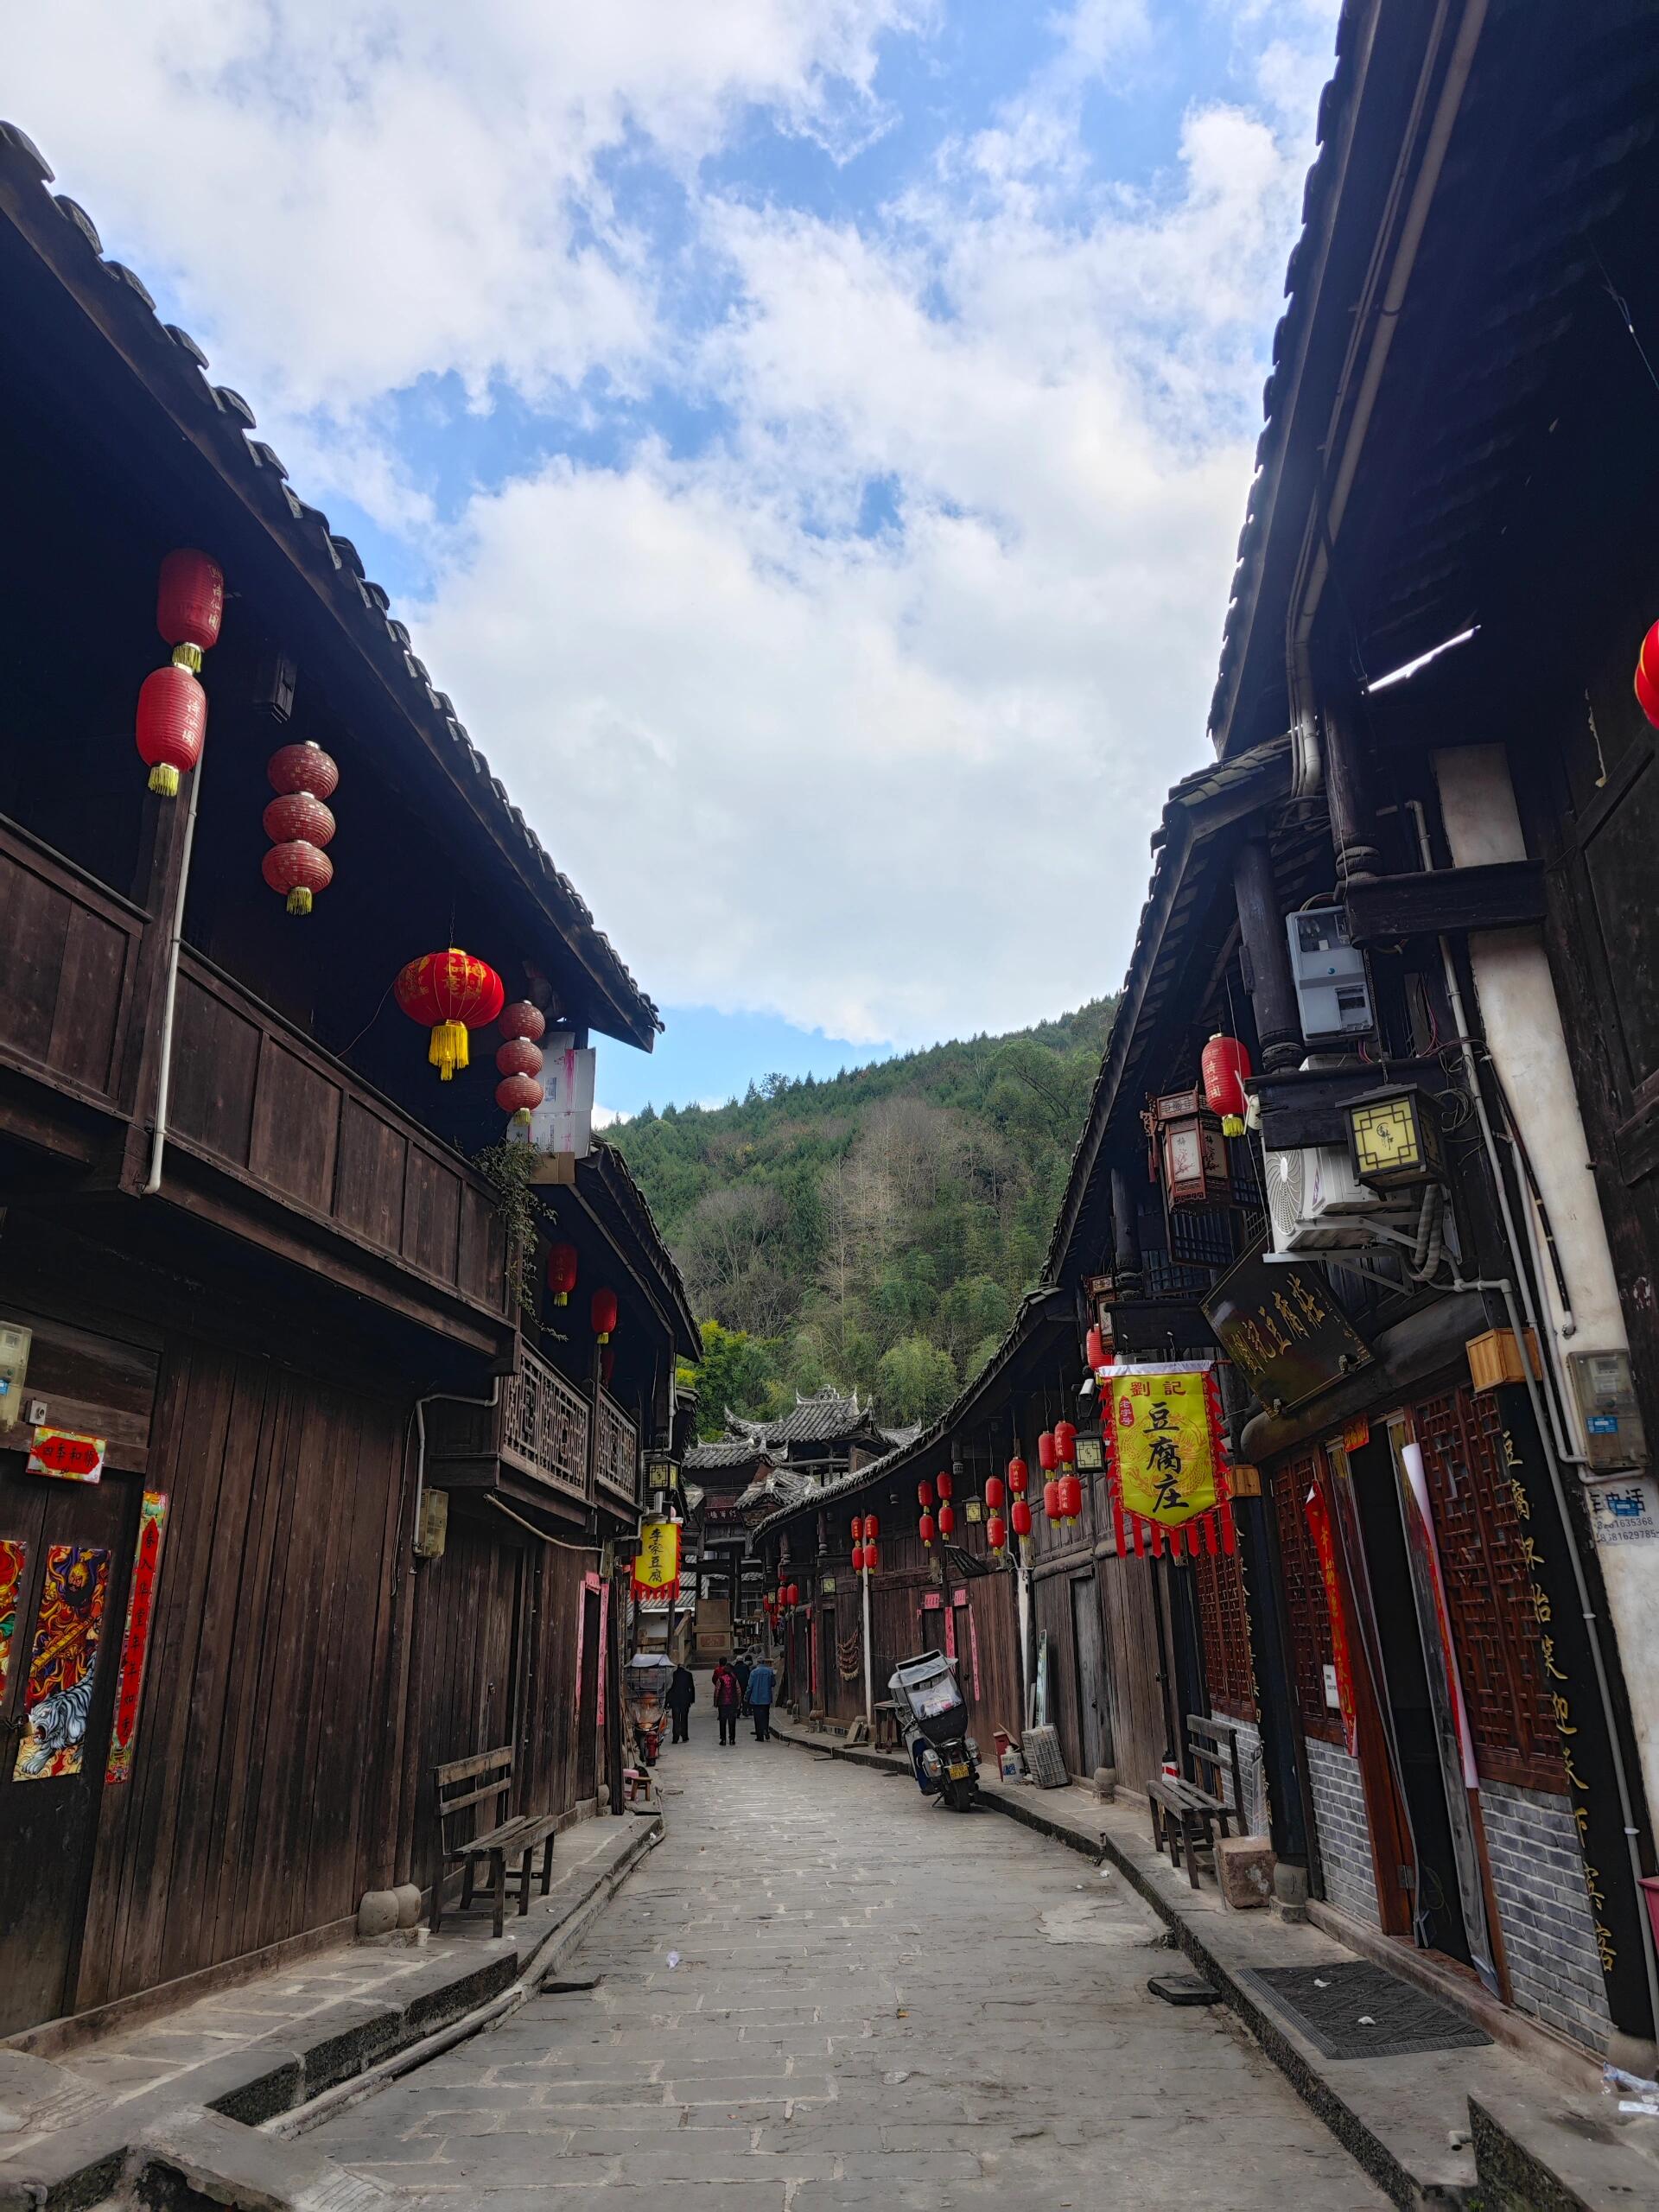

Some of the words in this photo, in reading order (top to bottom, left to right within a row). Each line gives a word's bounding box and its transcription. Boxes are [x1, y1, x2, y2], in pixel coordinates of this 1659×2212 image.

[1130, 1381, 1186, 1397] 劉記
[1142, 1402, 1190, 1513] 豆腐庄
[647, 1529, 664, 1583] 李家豆腐
